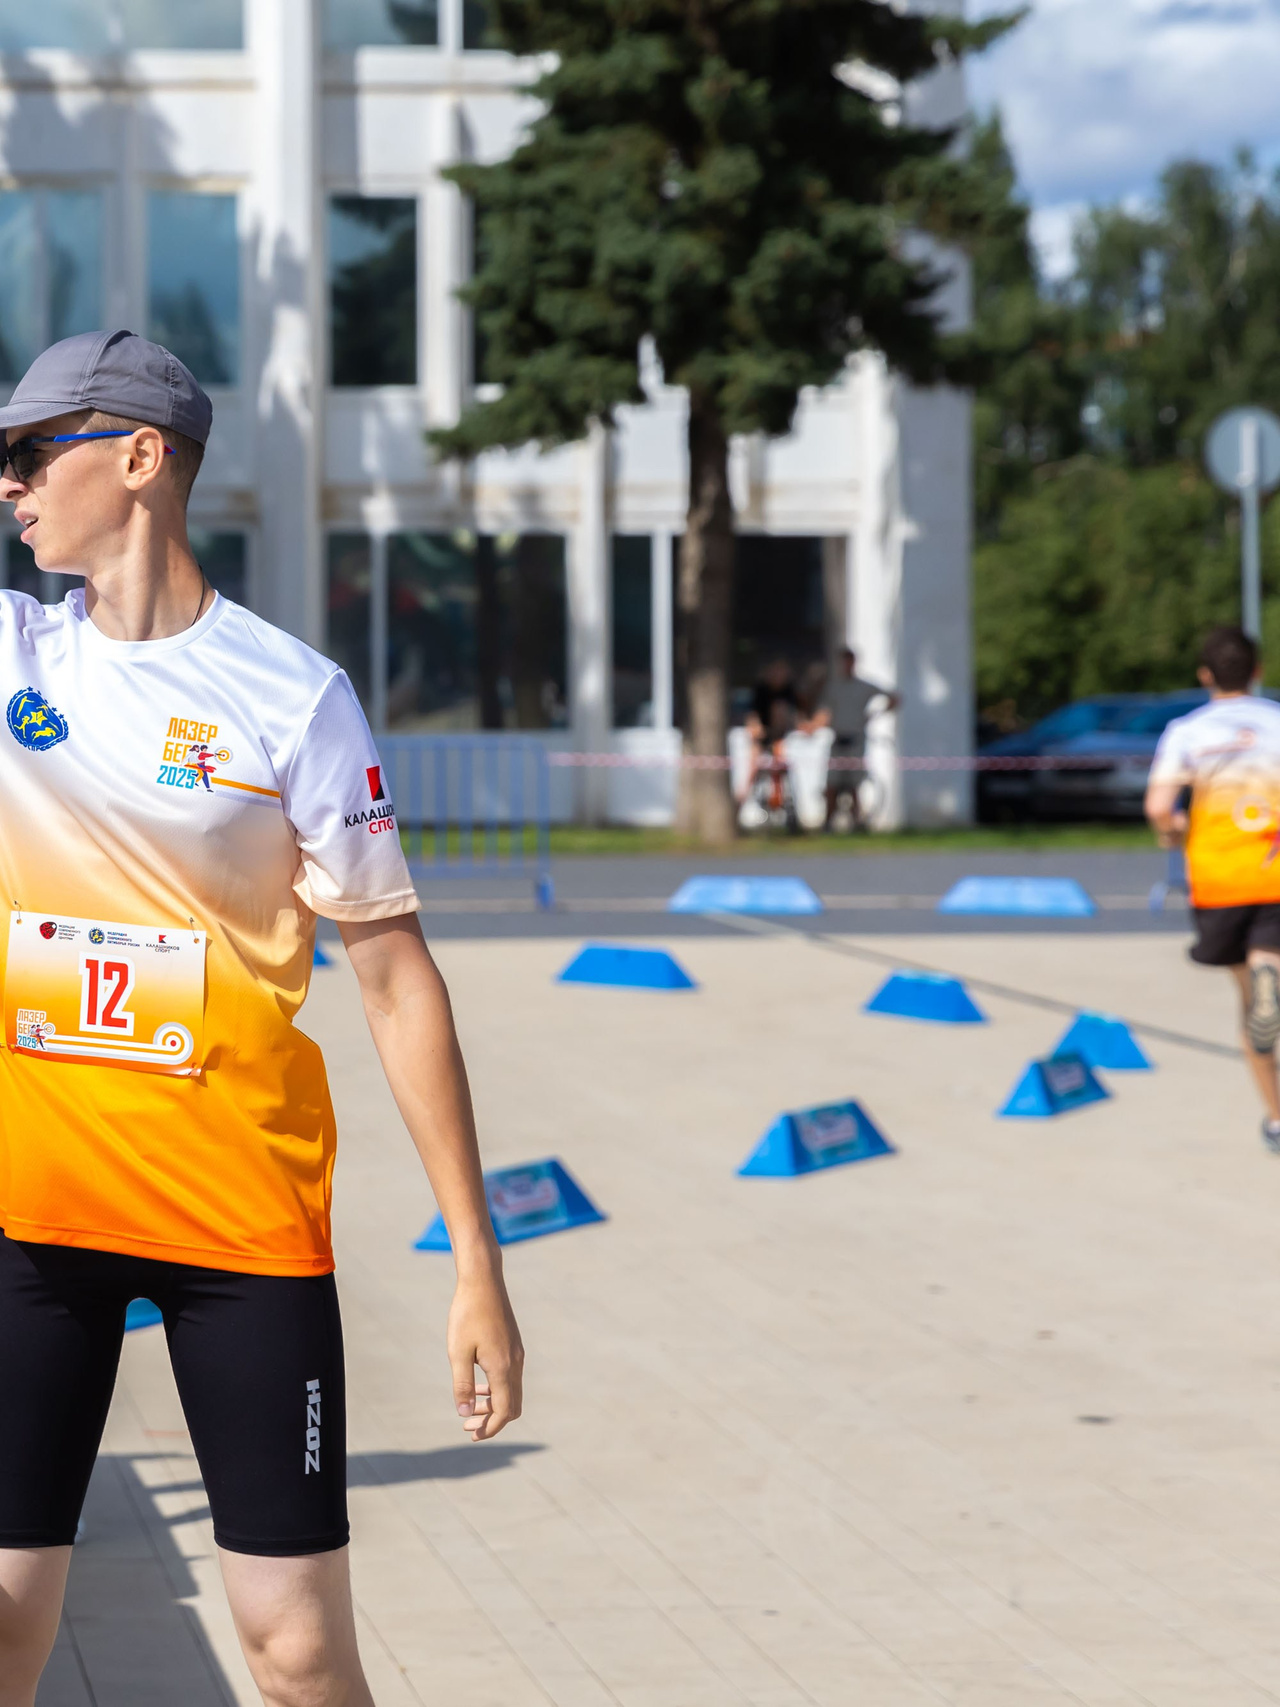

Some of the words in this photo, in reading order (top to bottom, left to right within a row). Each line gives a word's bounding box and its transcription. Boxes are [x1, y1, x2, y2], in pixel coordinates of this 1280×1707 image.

[166, 716, 219, 744] ЛАЗЕР
[162, 740, 192, 763] БЕГ
[156, 764, 197, 790] 2025
[85, 958, 129, 1029] 12
[18, 1010, 45, 1023] ЛАЗЕР
[17, 1035, 37, 1049] 2025
